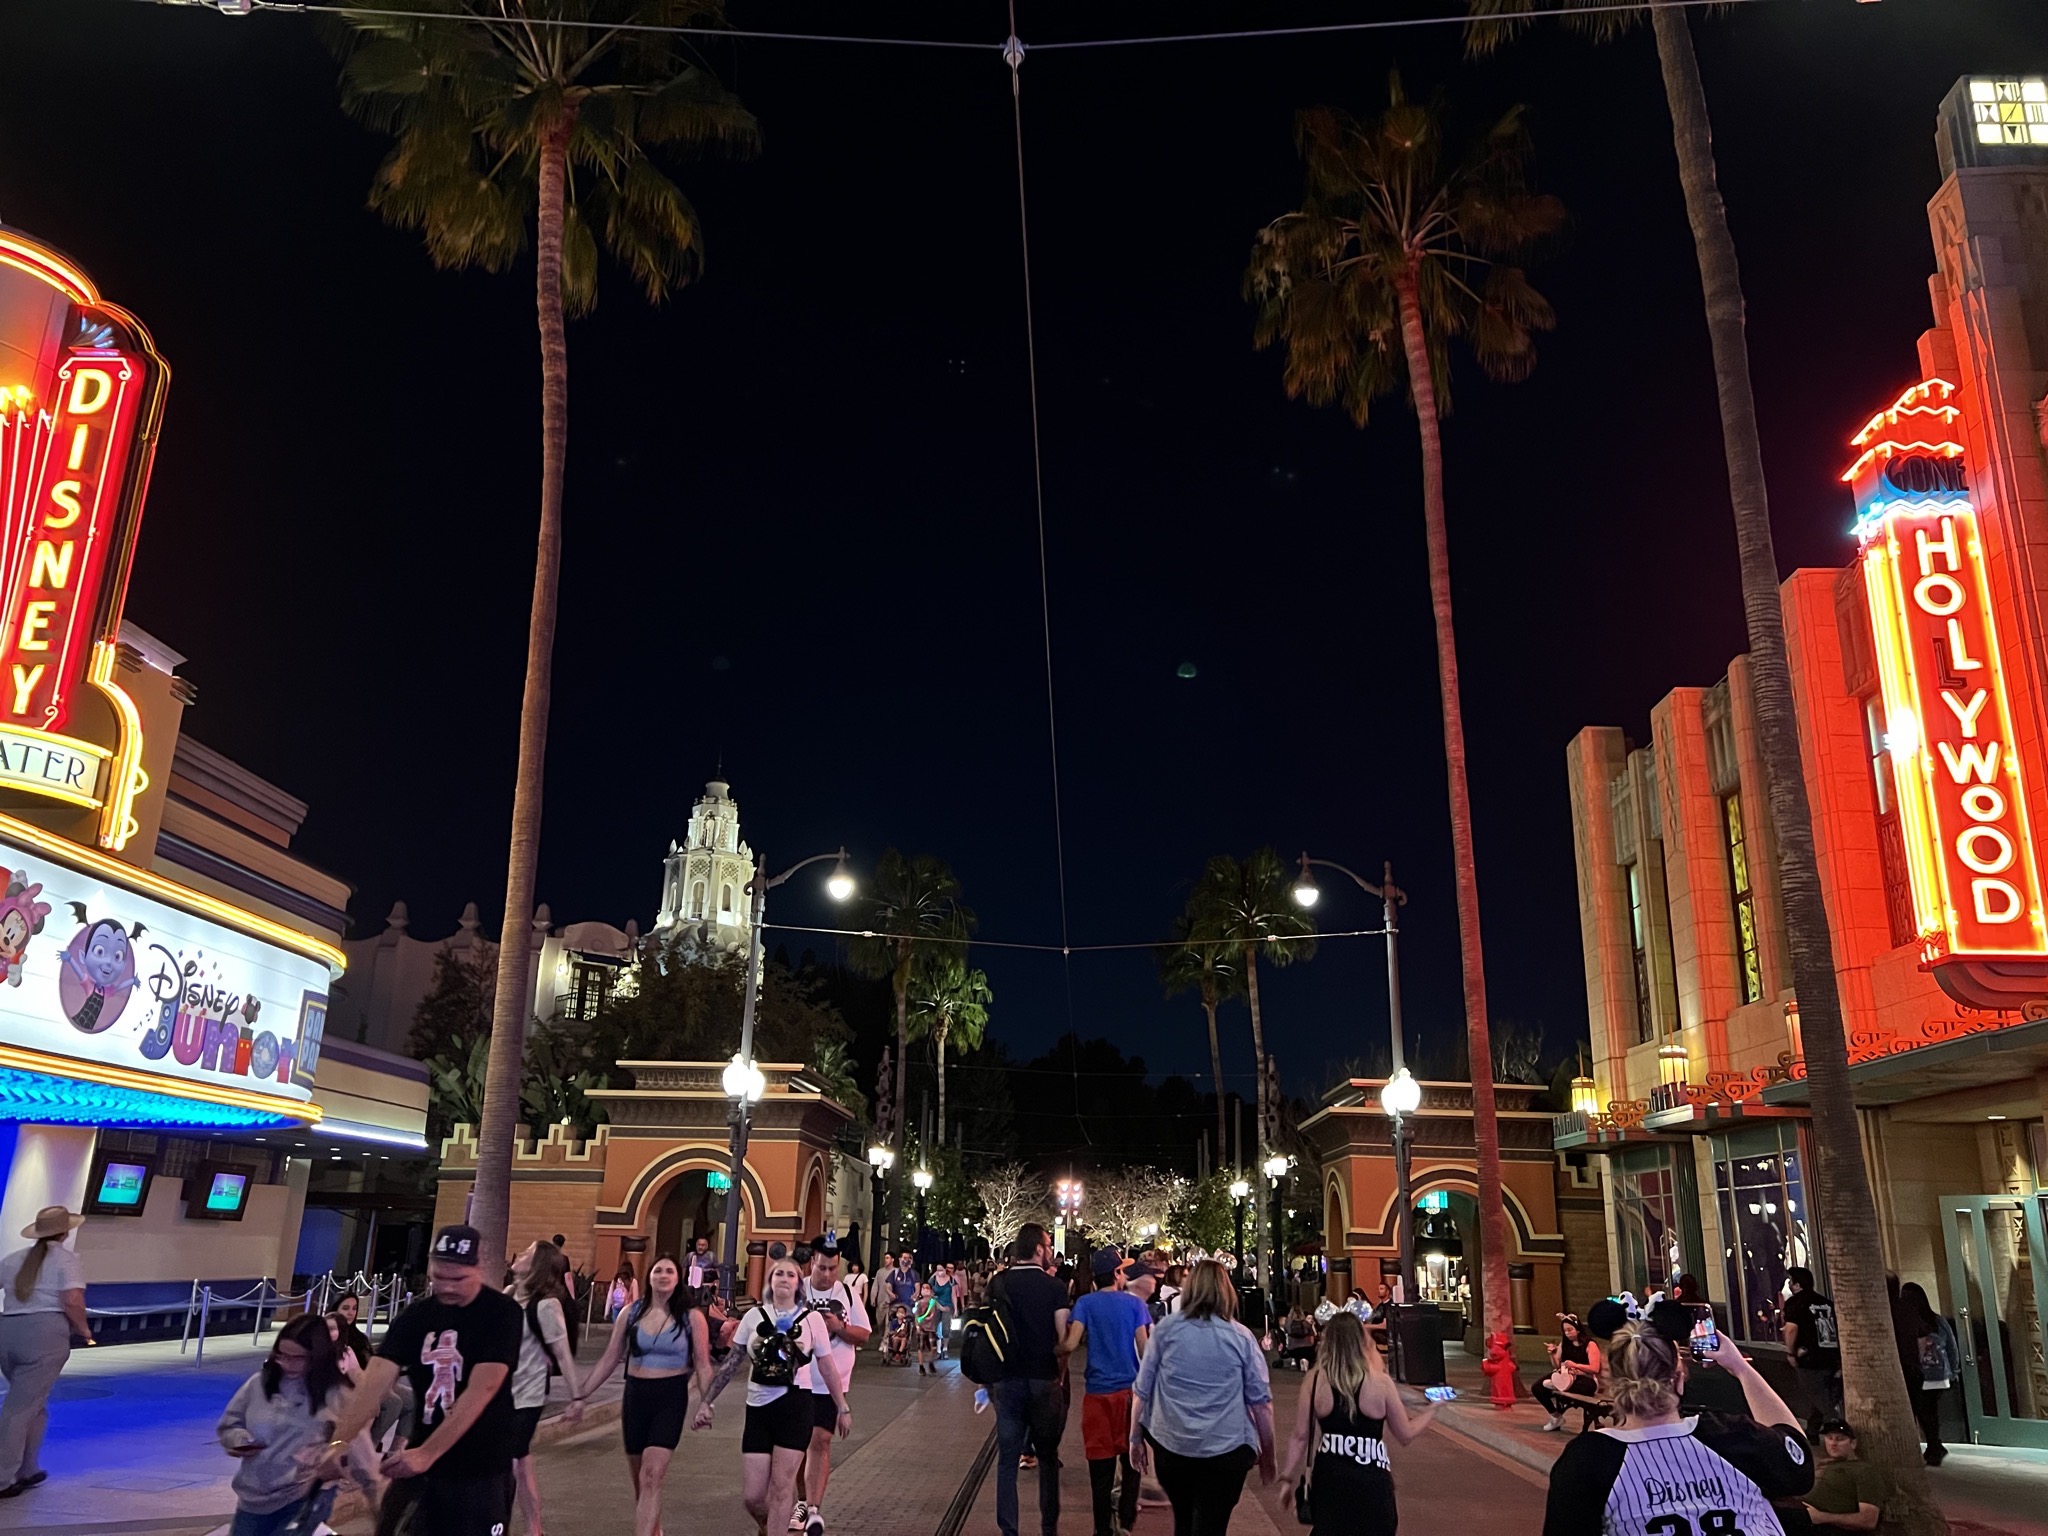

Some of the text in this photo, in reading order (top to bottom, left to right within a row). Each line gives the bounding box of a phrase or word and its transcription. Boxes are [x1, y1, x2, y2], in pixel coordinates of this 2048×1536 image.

[1885, 455, 1969, 492] GONE
[12, 368, 112, 715] DISNEY
[1913, 516, 2024, 924] HOLLYWOOD
[148, 943, 240, 1033] Disney
[1644, 1476, 1726, 1508] Disney
